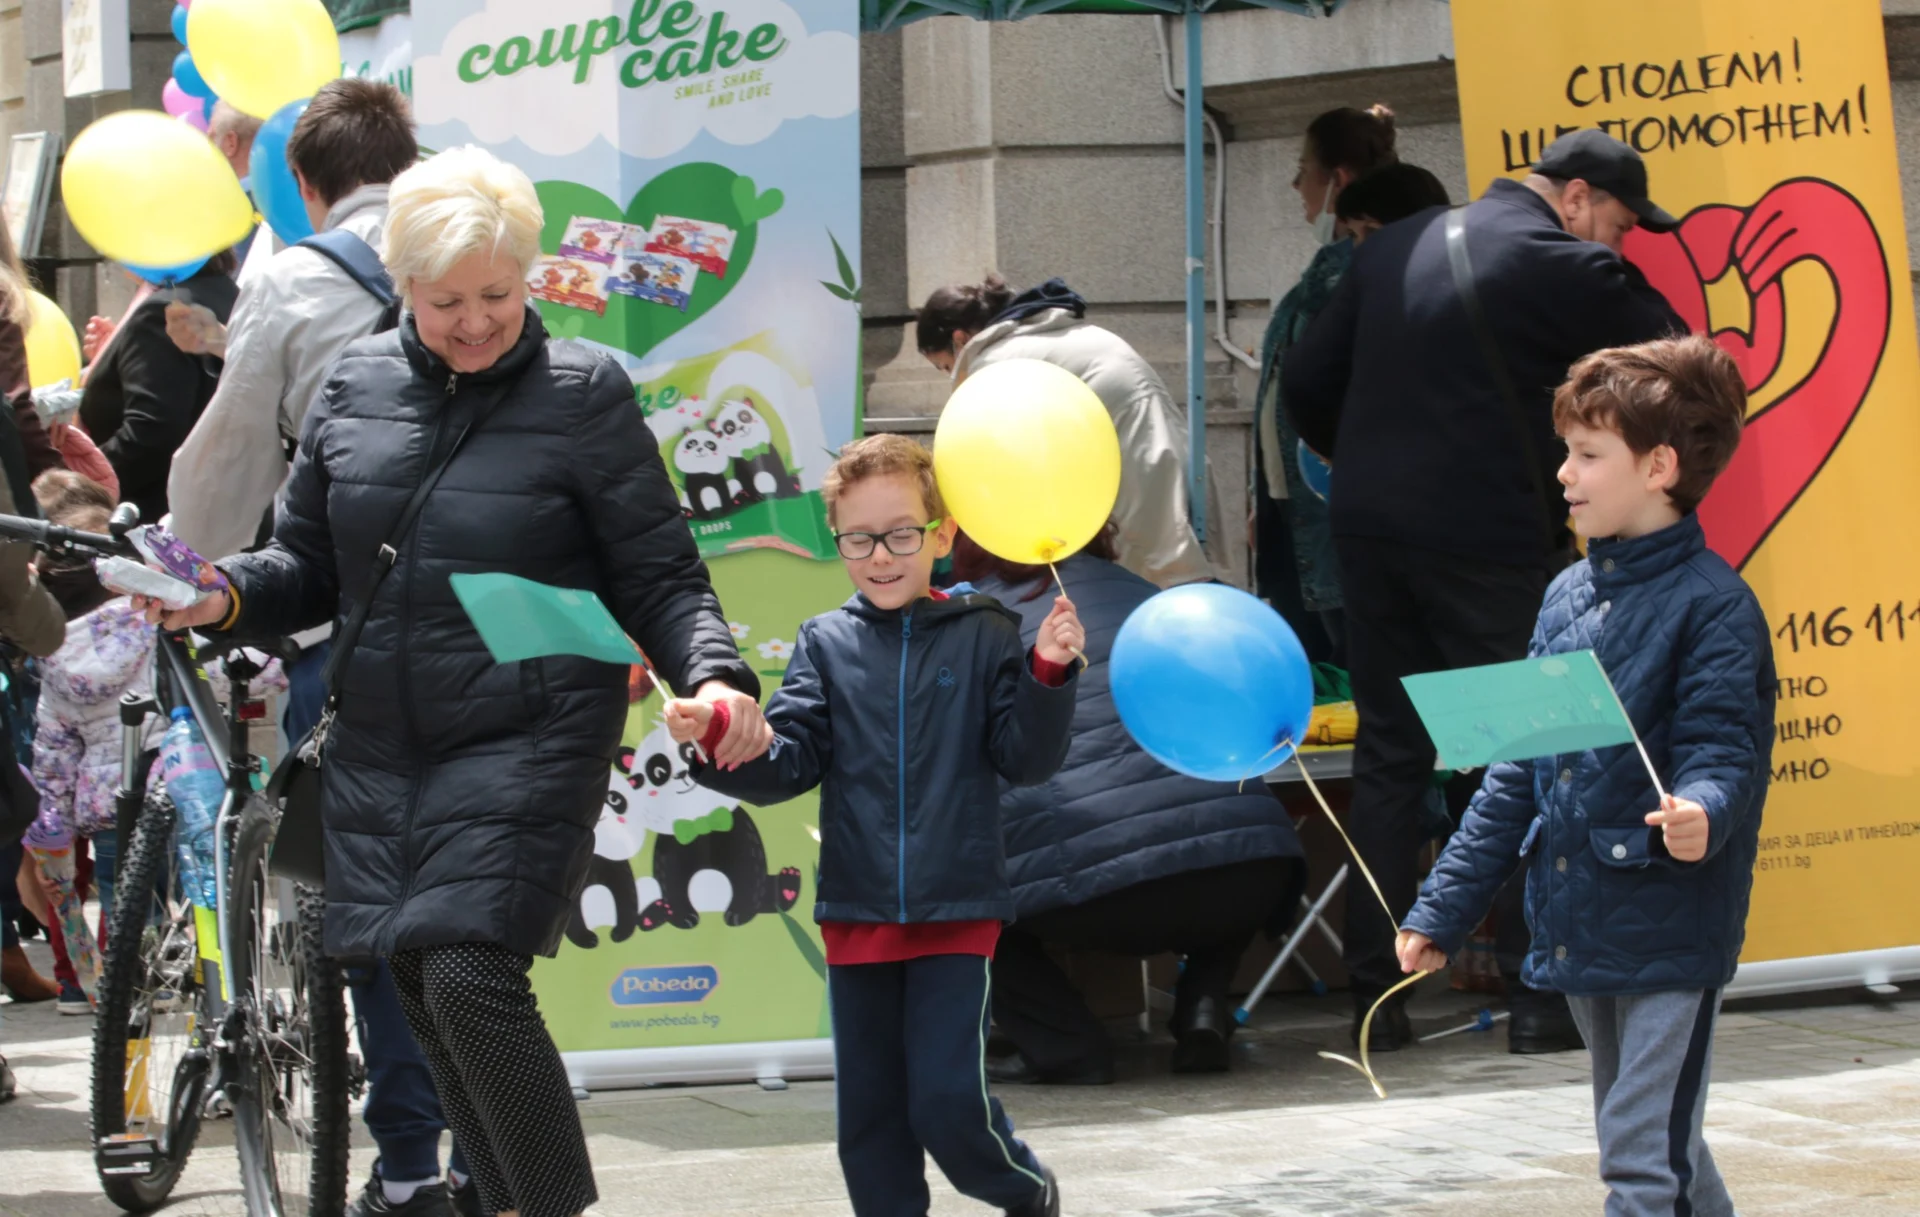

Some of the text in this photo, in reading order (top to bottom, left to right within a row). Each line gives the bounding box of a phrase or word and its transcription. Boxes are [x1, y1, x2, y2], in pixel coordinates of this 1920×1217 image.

[457, 0, 702, 84] couple
[620, 11, 787, 89] cake
[721, 68, 765, 89] SHARE
[1566, 36, 1804, 107] СПОДЕЛИ!
[707, 82, 773, 110] AND LOVE
[1597, 84, 1873, 154] ПОМОГНЕМ!
[700, 521, 733, 536] DROPS
[1776, 606, 1853, 653] 116
[1775, 713, 1842, 743] ЩНО
[1785, 835, 1802, 849] ЗА
[1805, 830, 1841, 848] ДЕЦА
[1844, 828, 1854, 842] И
[623, 975, 710, 995] Pobeda
[610, 1011, 720, 1031] www.pobeda.bg
